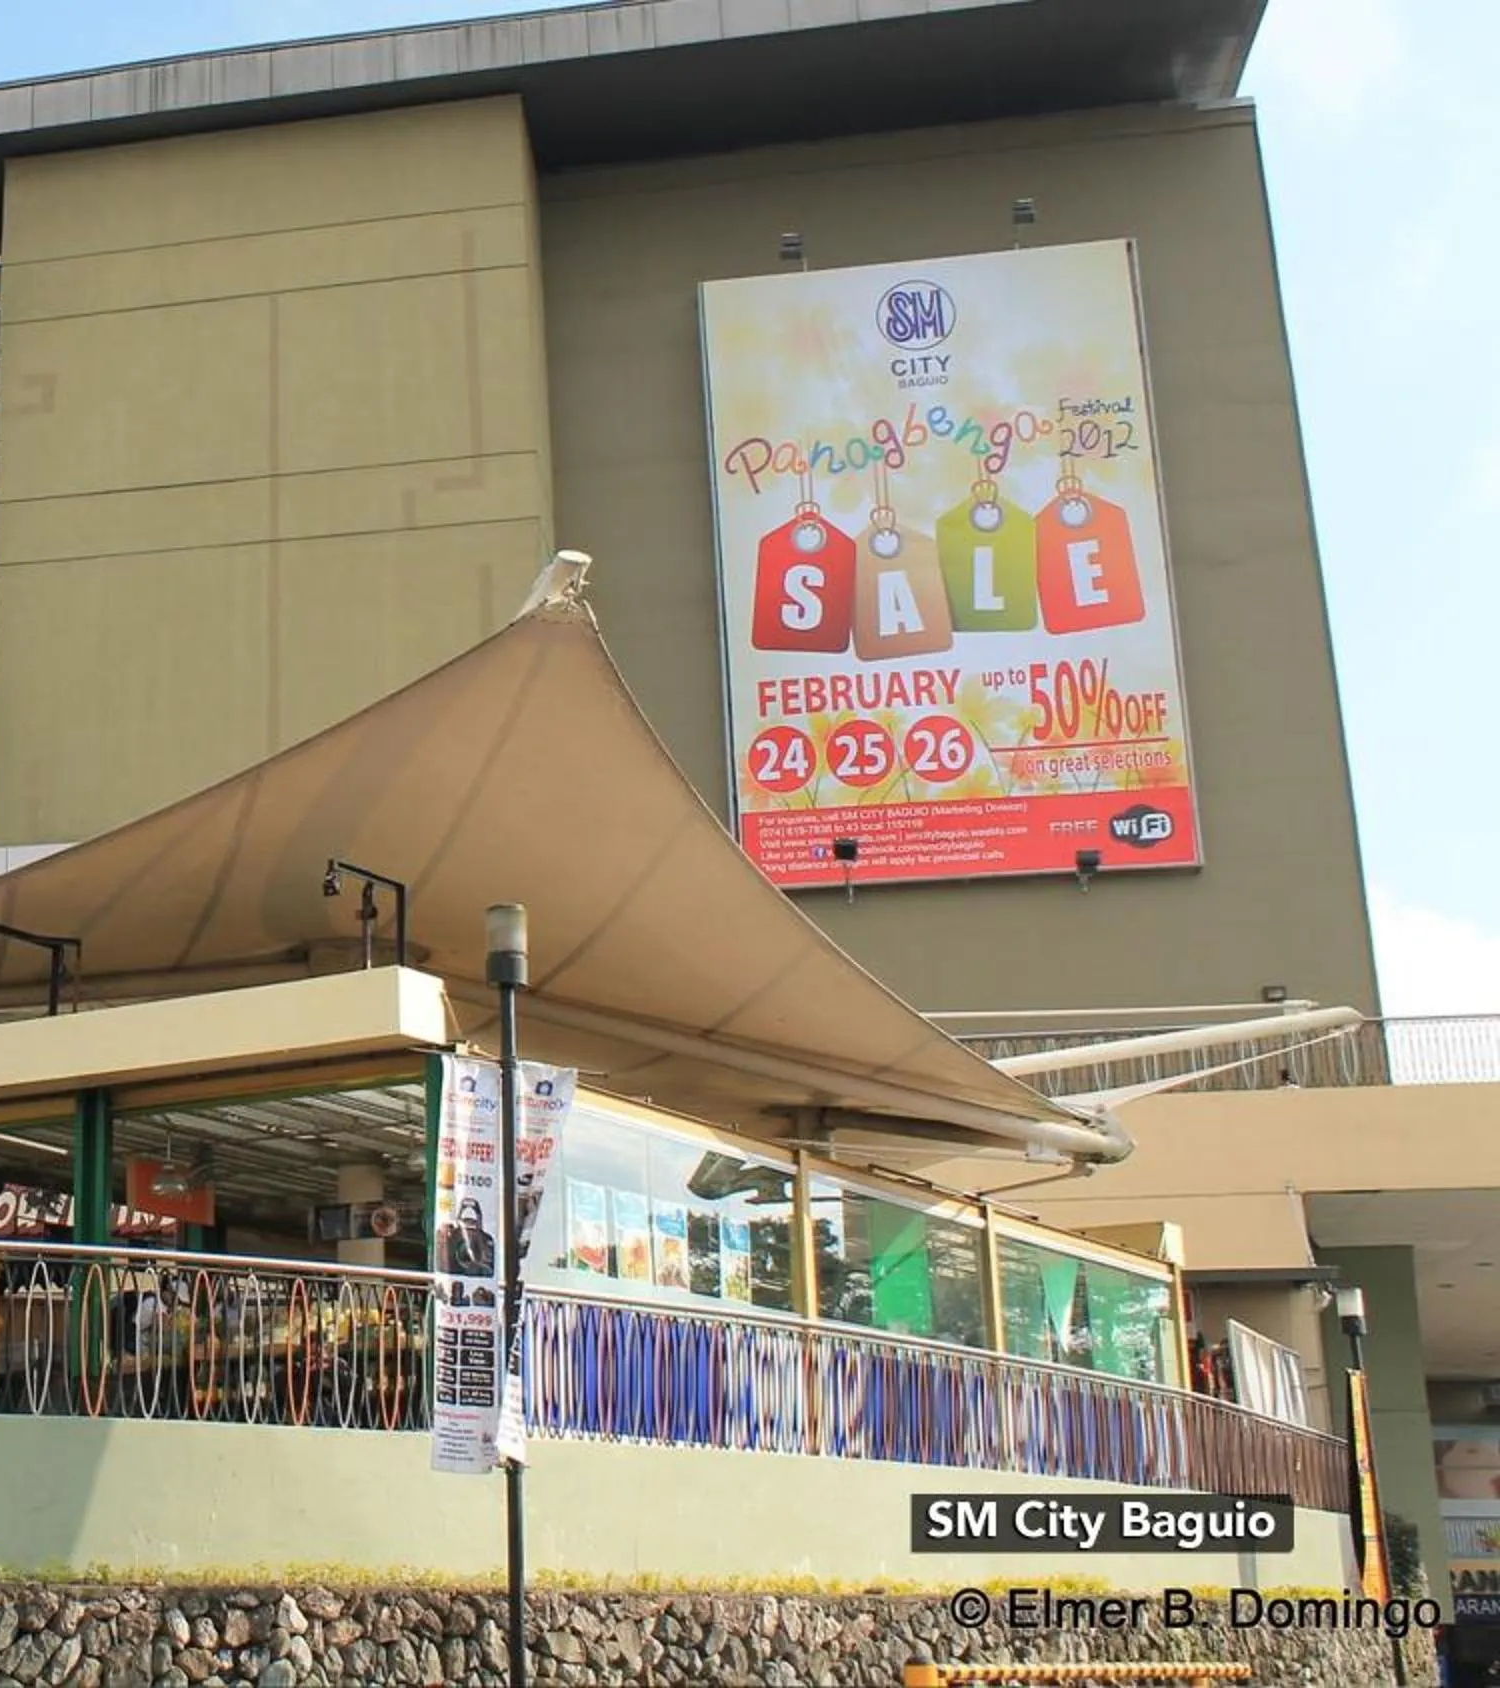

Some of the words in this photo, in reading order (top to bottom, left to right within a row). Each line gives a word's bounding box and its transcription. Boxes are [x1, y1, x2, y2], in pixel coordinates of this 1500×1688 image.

[886, 289, 945, 342] SM
[891, 354, 951, 377] CITY
[898, 375, 949, 390] BAGUIO
[1057, 396, 1135, 421] Festival
[725, 402, 1053, 496] Panagbenga
[1059, 419, 1139, 459] 2012
[756, 669, 960, 717] FEBRUARY
[982, 670, 1005, 691] up
[1008, 668, 1026, 686] to
[1029, 658, 1123, 741] 50%
[1124, 694, 1167, 733] OFF
[754, 737, 809, 781] 24
[834, 733, 887, 775] 25
[910, 728, 965, 771] 26
[1025, 759, 1045, 773] on
[1049, 754, 1090, 778] great
[1092, 749, 1172, 770] selections
[860, 809, 884, 821] CITY
[888, 807, 929, 818] BAGUIO
